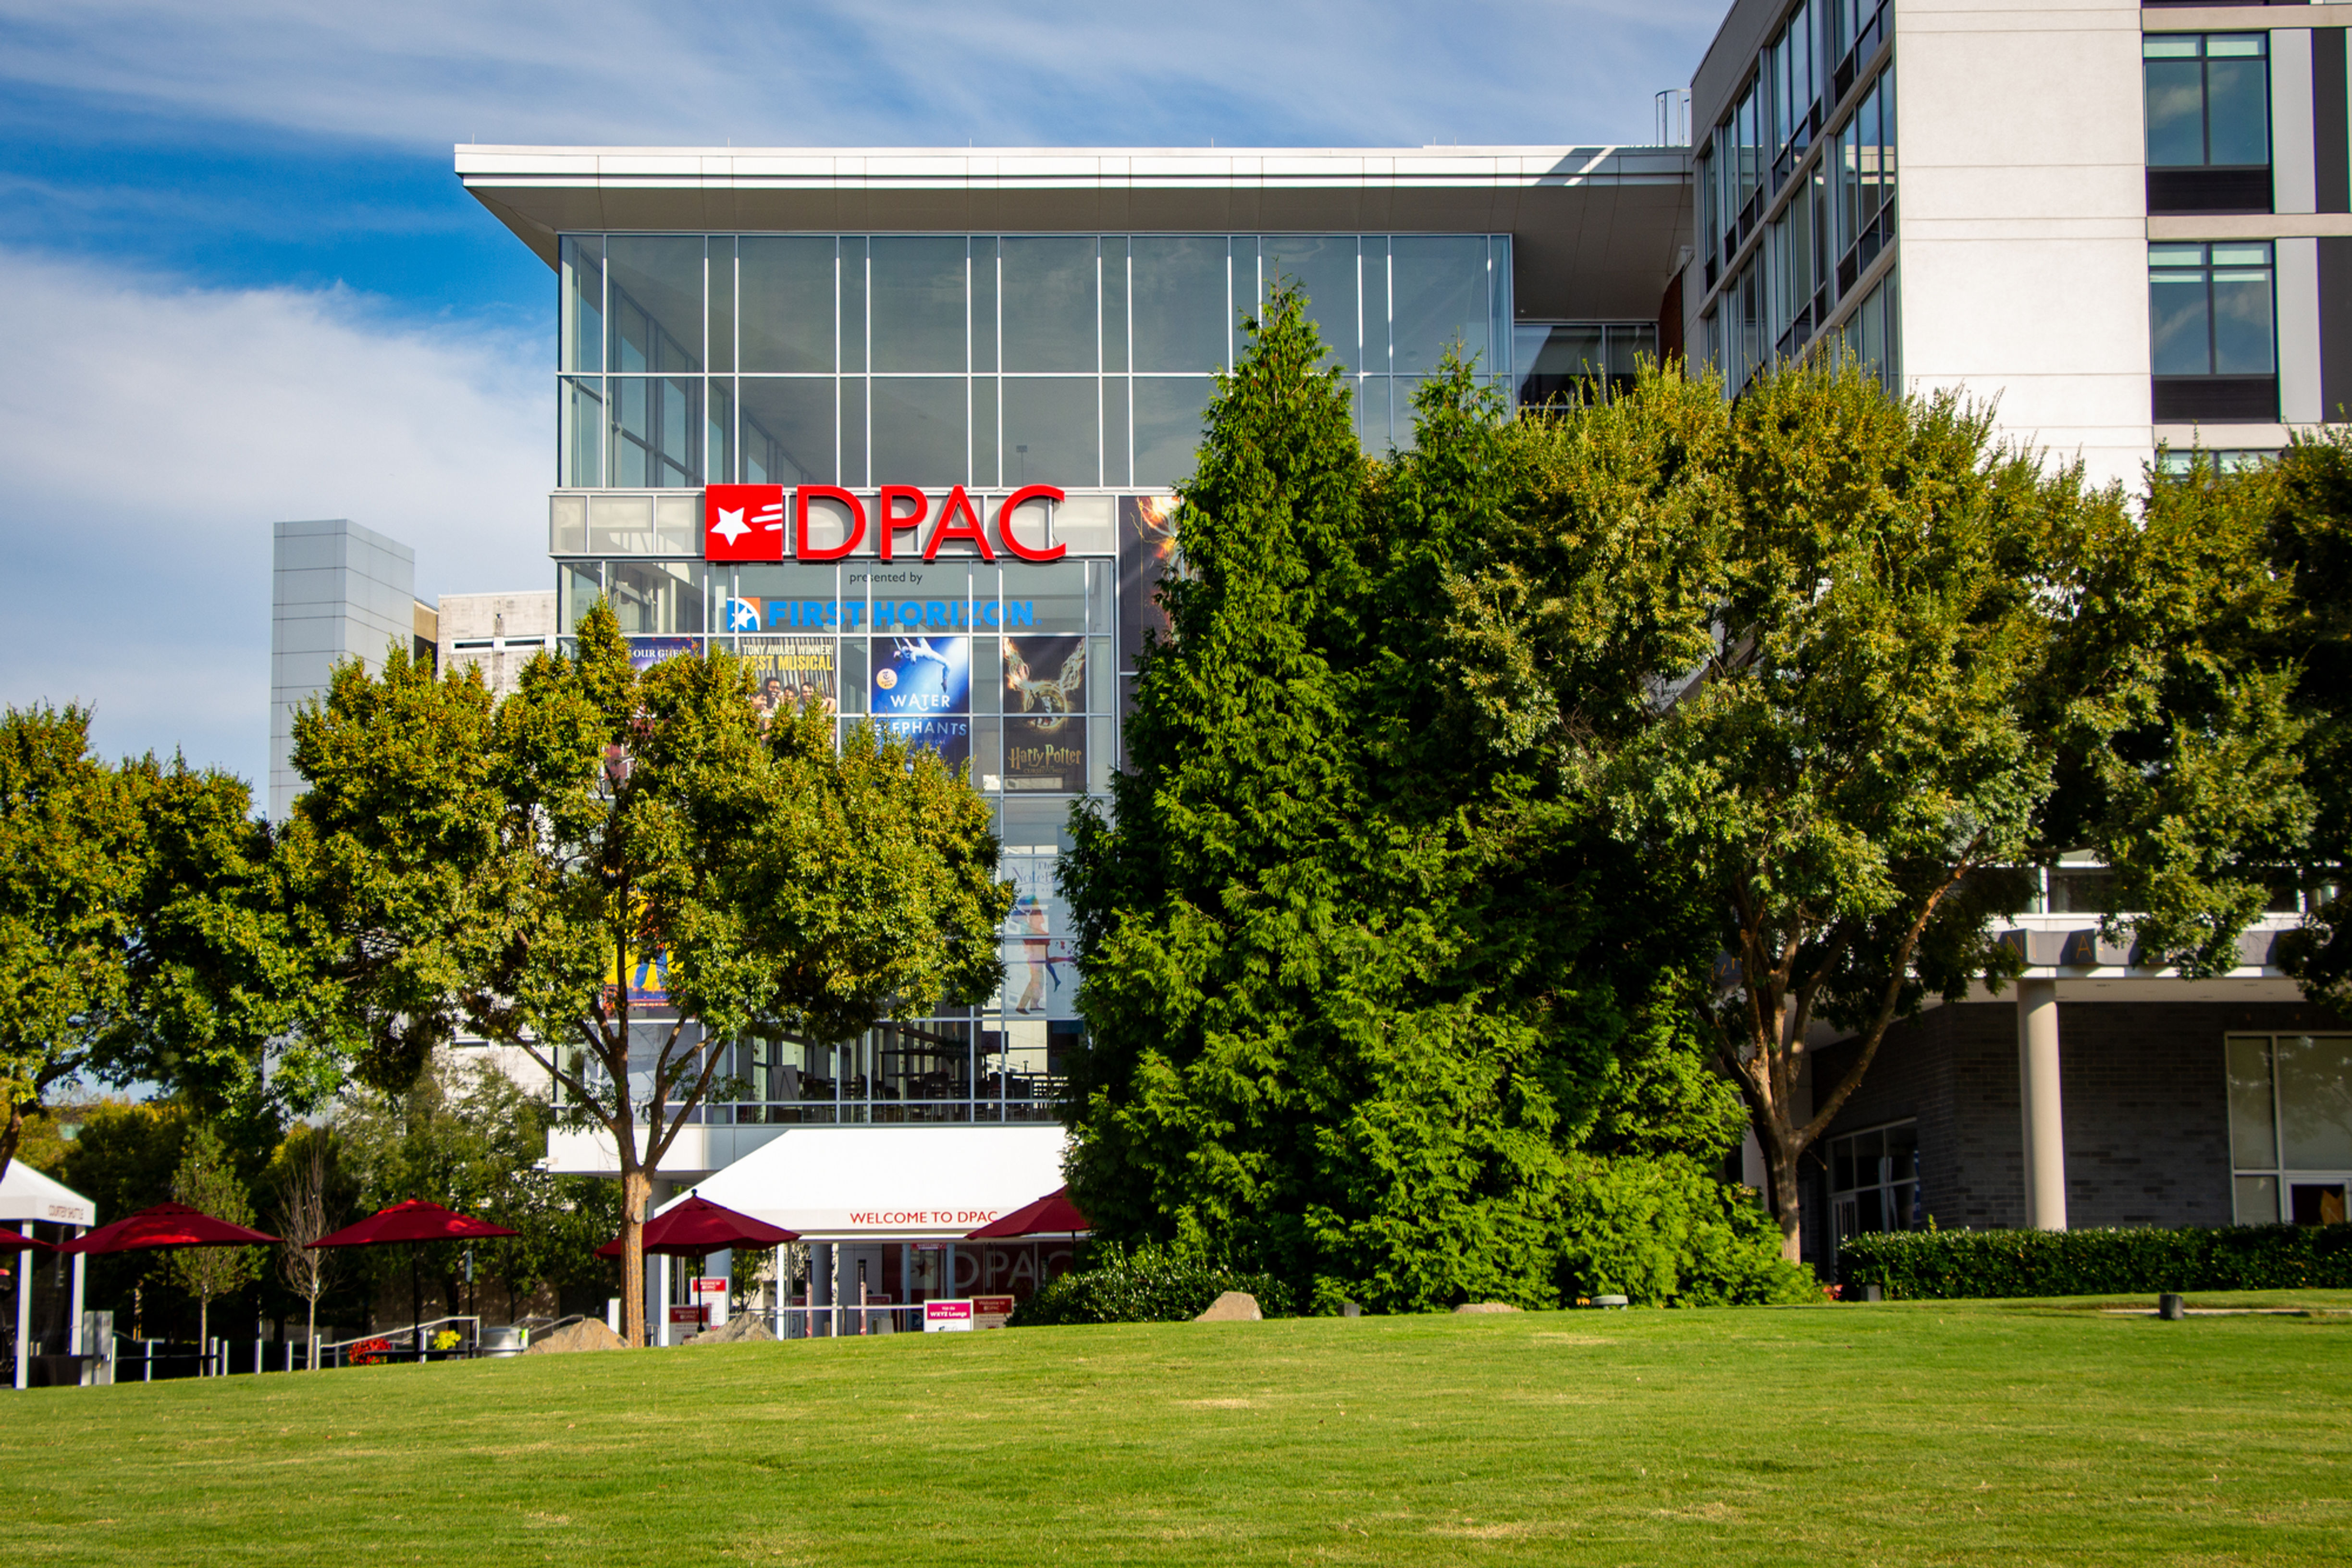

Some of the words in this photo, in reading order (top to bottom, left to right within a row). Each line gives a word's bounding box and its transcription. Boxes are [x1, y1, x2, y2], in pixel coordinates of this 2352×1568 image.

[796, 484, 1066, 561] DPAC
[850, 572, 905, 585] presented
[910, 572, 923, 585] by
[769, 601, 865, 627] FIRST
[874, 601, 1034, 627] HORIZON
[633, 649, 656, 658] OUR
[657, 649, 691, 658] GUE
[742, 644, 765, 655] TONY
[767, 644, 796, 655] AWARD
[798, 644, 834, 655] WINNER!
[742, 655, 775, 671] BEST
[778, 655, 834, 671] MUSICAL
[890, 693, 950, 711] WATER
[1008, 746, 1044, 770] Harry
[1045, 744, 1082, 769] Potter
[850, 1212, 927, 1223] WELCOME
[931, 1211, 952, 1223] TO
[958, 1211, 998, 1223] DPAC
